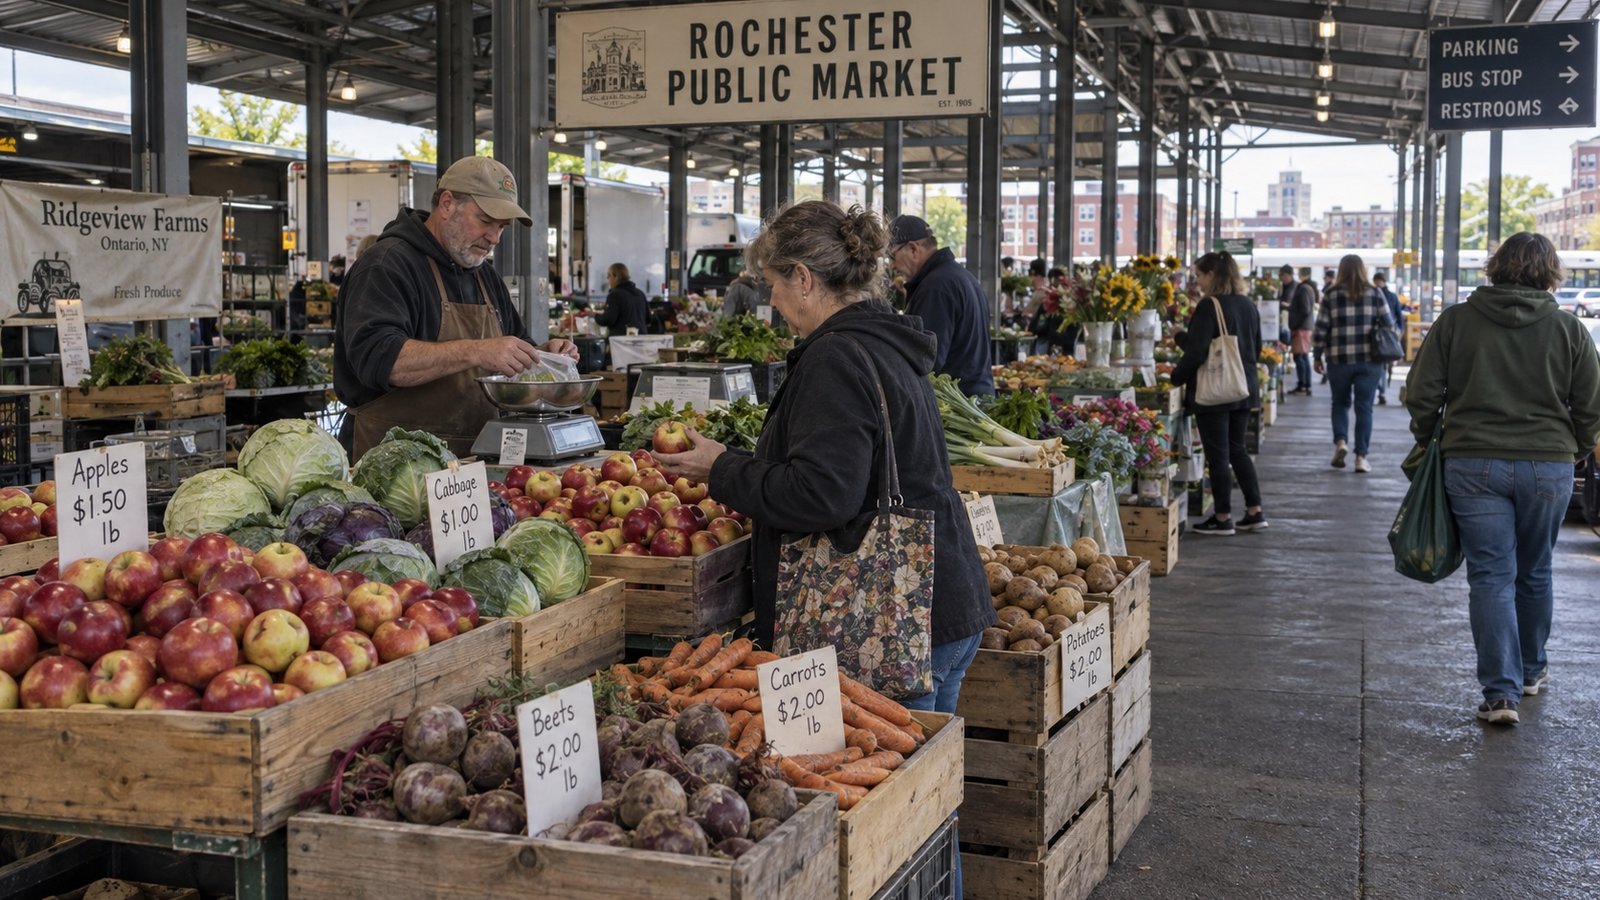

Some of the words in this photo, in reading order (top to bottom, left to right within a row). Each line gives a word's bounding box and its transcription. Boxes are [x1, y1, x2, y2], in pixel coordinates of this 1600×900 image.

[690, 10, 912, 59] ROCHESTER
[1442, 38, 1519, 58] PARKING
[668, 64, 791, 106] PUBLIC
[812, 56, 962, 101] MARKET
[1441, 71, 1474, 89] BUS
[1481, 69, 1523, 87] STOP
[938, 100, 953, 108] EST.
[956, 98, 972, 107] 1905
[1441, 99, 1542, 119] RESTROOMS
[41, 199, 147, 236] Ridgeview
[153, 207, 209, 233] Farms
[100, 235, 150, 254] Ontario,
[152, 237, 170, 252] NY
[114, 285, 141, 299] Fresh
[144, 285, 182, 299] Produce
[72, 453, 129, 489] Apples
[434, 474, 478, 500] Cabbage
[73, 488, 127, 526] $1.50
[441, 503, 478, 537] $1.00
[103, 520, 120, 545] lb
[463, 529, 476, 551] lb
[1066, 623, 1105, 654] Potatoes
[770, 658, 827, 691] Carrots
[1088, 670, 1098, 688] lb
[531, 699, 575, 736] Beets
[807, 715, 821, 735] lb
[564, 766, 578, 792] lb
